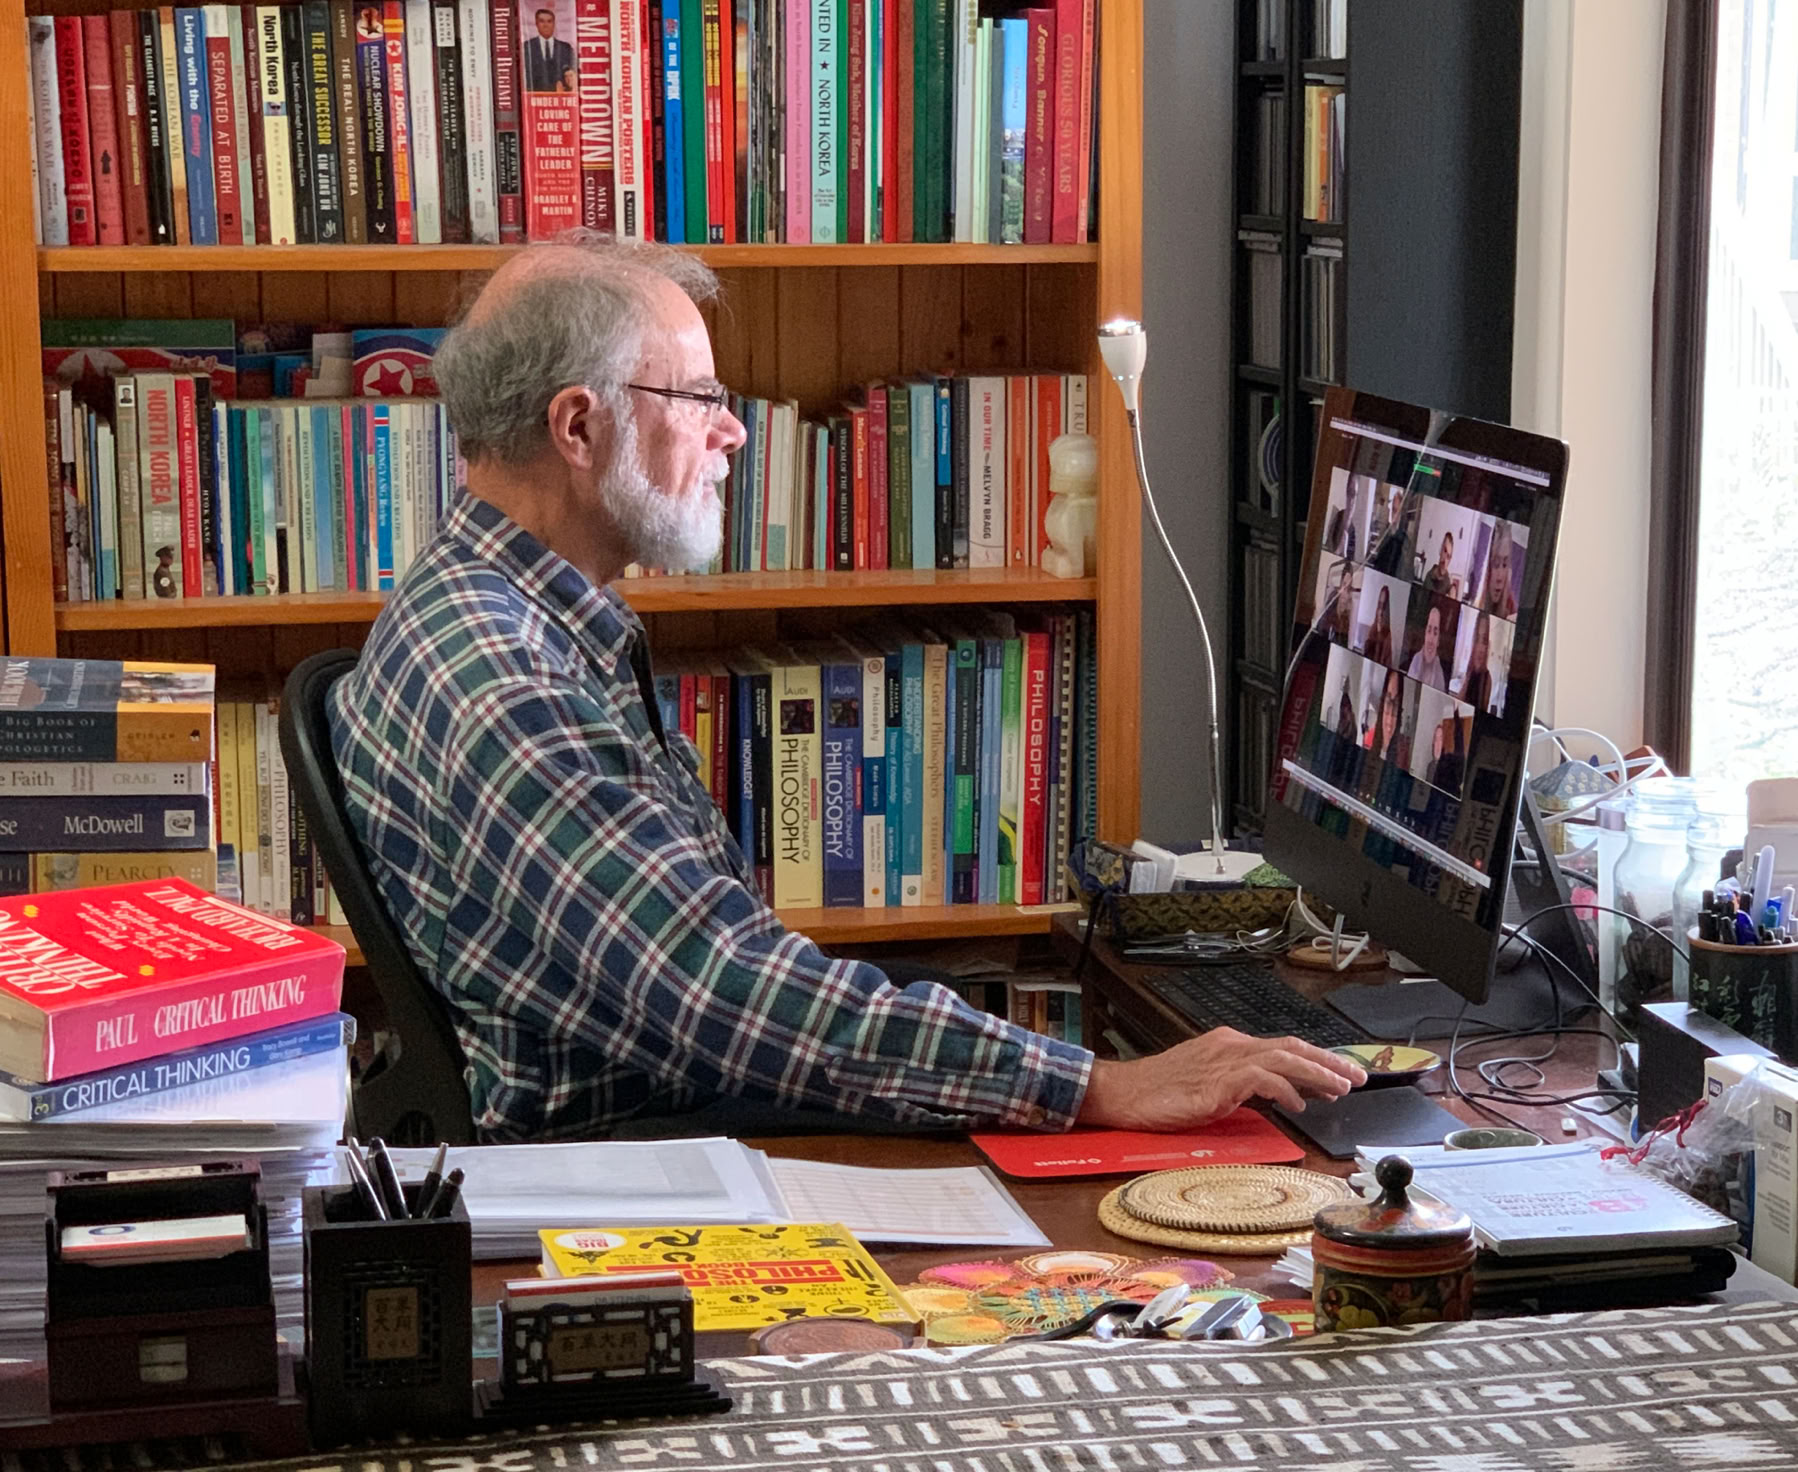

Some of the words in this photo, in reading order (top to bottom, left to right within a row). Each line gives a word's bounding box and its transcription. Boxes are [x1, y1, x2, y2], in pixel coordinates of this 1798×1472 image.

[468, 8, 476, 42] NOTHING
[494, 7, 511, 52] ROGUE
[619, 1, 630, 51] NORTH
[851, 4, 862, 26] Kim
[144, 35, 152, 46] THE
[183, 15, 194, 54] Living
[263, 15, 278, 53] North
[311, 32, 326, 50] THE
[668, 42, 677, 51] OF
[818, 38, 830, 52] IN
[144, 48, 154, 79] CLEANEST
[469, 45, 476, 57] TO
[668, 54, 678, 66] THE
[164, 56, 175, 77] THE
[186, 57, 198, 86] with
[266, 56, 280, 96] Korea
[312, 53, 328, 84] GREAT
[340, 58, 351, 80] THE
[370, 46, 382, 89] NUCLEAR
[392, 62, 404, 92] KIM
[470, 59, 478, 79] ENVY
[1060, 34, 1074, 117] GLORIOUS
[147, 80, 156, 96] RACE
[211, 52, 229, 124] SEPARATED
[448, 76, 456, 101] GREAT
[496, 57, 514, 110] REGIME
[576, 17, 612, 162] MELTDOWN
[620, 56, 632, 114] KOREAN
[667, 70, 680, 100] DPRK
[167, 82, 179, 132] KOREAN
[188, 88, 199, 110] the
[342, 86, 354, 112] REAL
[530, 97, 560, 108] UNDER
[562, 96, 578, 107] THE
[818, 79, 831, 128] NORTH
[850, 83, 862, 122] Mother
[314, 88, 332, 145] SUCCESSOR
[372, 92, 385, 152] SHOWDOWN
[394, 94, 407, 152] JONG-IL:
[449, 104, 457, 133] LEADER
[537, 122, 560, 132] CARE
[562, 122, 572, 132] OF
[539, 109, 570, 120] LOVING
[1059, 120, 1074, 138] 50
[190, 114, 201, 158] Enemy
[216, 131, 230, 146] AT
[344, 116, 356, 154] NORTH
[548, 134, 564, 145] THE
[850, 125, 862, 136] of
[170, 134, 181, 160] WAR
[316, 154, 329, 170] KIM
[535, 146, 575, 158] FATHERLY
[622, 118, 634, 185] POSTERS
[818, 132, 831, 177] KOREA
[850, 138, 861, 170] Korea
[218, 156, 233, 194] BIRTH
[347, 159, 358, 196] KOREA
[510, 156, 518, 176] JONG
[540, 160, 572, 170] LEADER
[1058, 142, 1072, 194] YEARS
[318, 173, 330, 196] JONG
[512, 179, 518, 188] IL
[319, 199, 332, 210] UN
[542, 206, 573, 216] MARTIN
[585, 177, 596, 228] CHINOY
[597, 186, 608, 221] MIKE
[182, 396, 192, 428] LINTNER
[984, 392, 992, 402] IN
[147, 390, 168, 446] NORTH
[984, 406, 992, 425] OUR
[1074, 401, 1084, 432] TRU
[184, 440, 194, 464] GREAT
[840, 428, 848, 462] WISDOM
[940, 428, 948, 454] Thinking
[984, 428, 992, 451] TIME
[302, 431, 310, 481] REVOLUTION
[377, 436, 388, 497] PYONGYANG
[392, 432, 400, 481] REVOLUTION
[840, 463, 848, 473] OF
[150, 452, 172, 505] KOREA
[184, 466, 196, 495] LEADER,
[840, 475, 848, 490] THE
[983, 466, 992, 506] MELVYN
[186, 498, 196, 518] DEAR
[202, 489, 210, 516] HYOK
[378, 499, 388, 526] Review
[151, 511, 163, 543] FRENCH
[164, 516, 173, 536] PAUL
[304, 501, 312, 541] CREATION
[840, 492, 849, 544] MILLENNIUM
[983, 508, 992, 540] BRAGG
[186, 520, 198, 548] LEADER
[930, 656, 943, 680] The
[833, 686, 856, 694] AUDI
[930, 682, 943, 718] Great
[6, 717, 30, 727] BIG
[37, 716, 75, 727] BOOK
[80, 718, 96, 727] OF
[870, 686, 880, 742] Philosophy
[912, 677, 922, 754] UNDERSTANDING
[801, 738, 809, 752] THE
[888, 732, 898, 756] Theory
[1028, 670, 1044, 806] PHILOSOPHY
[742, 738, 752, 800] KNOWLEDGE?
[926, 722, 943, 798] Philosophers
[112, 774, 157, 784] CRAIG
[800, 755, 809, 799] CAMBRIDGE
[845, 756, 853, 799] CAMBRIDGE
[888, 766, 898, 804] Knowledge
[781, 738, 800, 864] PHILOSOPHY
[825, 742, 842, 858] PHILOSOPHY
[870, 785, 880, 808] Simple
[64, 814, 144, 834] McDowell
[801, 802, 810, 847] DICTIONARY
[845, 800, 853, 846] DICTIONARY
[930, 816, 938, 858] STEPHEN
[802, 850, 810, 862] OF
[846, 849, 854, 860] OF
[93, 864, 176, 881] PEARCEY
[143, 885, 201, 921] PAUL
[196, 908, 304, 950] RICHARD
[96, 1014, 138, 1053] PAUL
[154, 992, 227, 1038] CRITICAL
[231, 975, 307, 1019] THINKING
[682, 1265, 836, 1280] PHILOSO
[692, 1262, 746, 1270] BOOK
